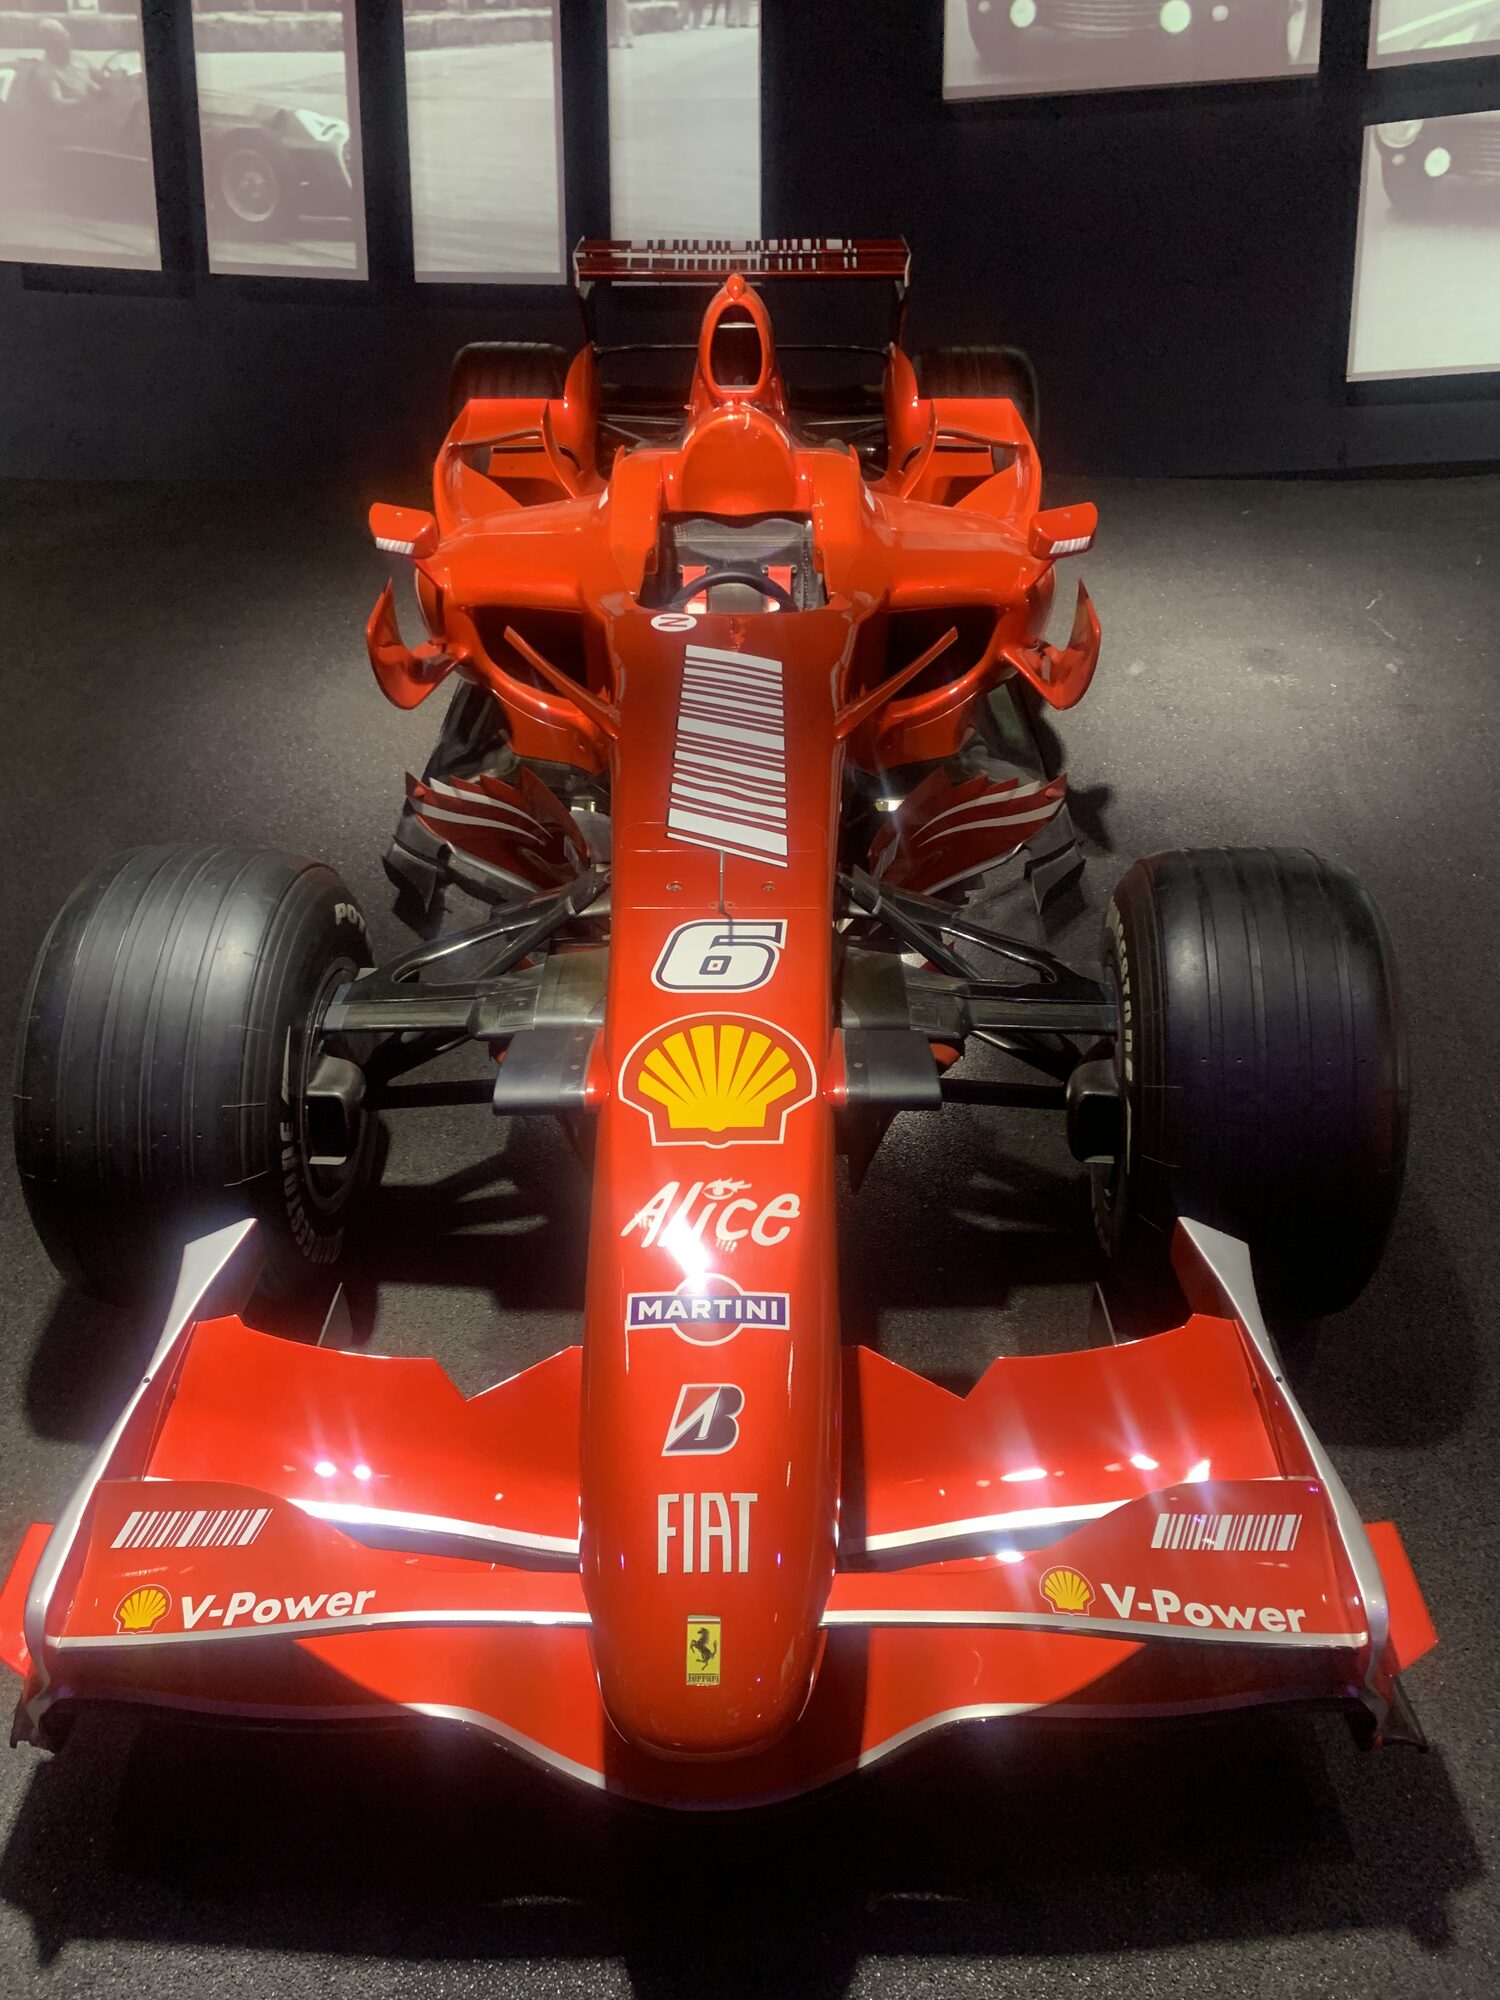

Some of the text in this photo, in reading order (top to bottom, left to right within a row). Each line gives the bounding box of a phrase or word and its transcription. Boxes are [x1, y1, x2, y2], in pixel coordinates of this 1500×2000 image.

[651, 919, 788, 993] 6
[620, 1178, 801, 1250] Alice
[637, 1299, 778, 1321] MARTINI
[657, 1492, 758, 1574] FIAT
[181, 1590, 377, 1629] V-Power
[1100, 1583, 1306, 1632] V-Power
[688, 1672, 719, 1683] Ferrari
